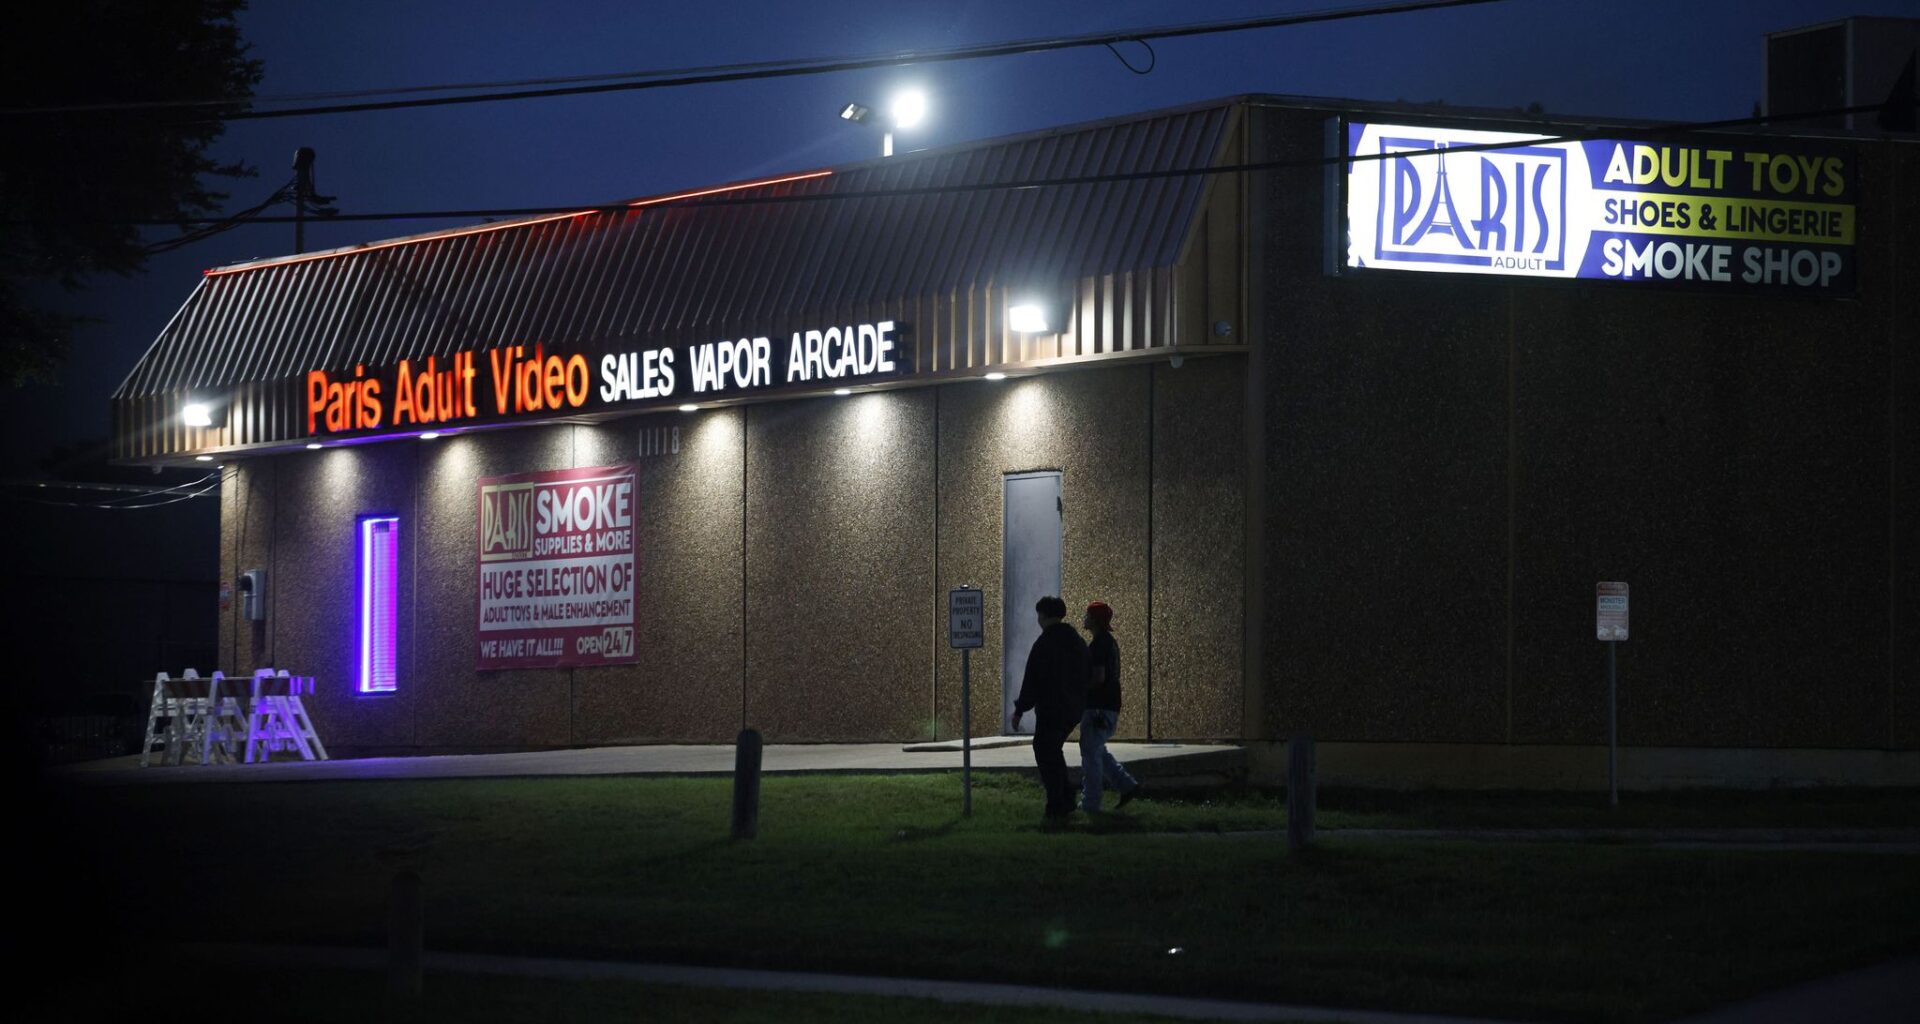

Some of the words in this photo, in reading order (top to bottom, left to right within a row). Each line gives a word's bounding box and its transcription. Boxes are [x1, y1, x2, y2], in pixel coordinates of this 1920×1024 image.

[1603, 142, 1732, 191] ADULT
[1745, 152, 1845, 197] TOYS
[1392, 140, 1551, 253] PARIS
[1604, 198, 1691, 229] SHOES
[1698, 206, 1717, 230] &
[1725, 208, 1842, 238] LINGERIE
[1494, 256, 1543, 271] ADULT
[1601, 238, 1732, 282] SMOKE
[1742, 244, 1842, 287] SHOP
[308, 362, 382, 434] Paris
[393, 350, 477, 425] Adult
[491, 342, 589, 414] Video
[600, 347, 675, 402] SALES
[689, 337, 771, 392] VAPOR
[787, 321, 895, 382] ARCADE
[638, 426, 680, 457] 11118
[484, 484, 530, 551] PARIS
[536, 483, 632, 535] SMOKE
[535, 537, 582, 556] SUPPLIES
[585, 534, 593, 551] &
[596, 530, 631, 551] MORE
[483, 568, 523, 600] HUGE
[526, 564, 607, 598] SELECTION
[611, 562, 632, 593] OF
[483, 605, 509, 623] ADULT
[510, 604, 531, 621] TOYS
[533, 605, 539, 620] &
[541, 602, 564, 619] MALE
[566, 599, 631, 618] ENHANCEMENT
[960, 619, 972, 629] NO
[480, 640, 497, 657] WE
[500, 638, 525, 656] HAVE
[576, 635, 601, 655] OPEN
